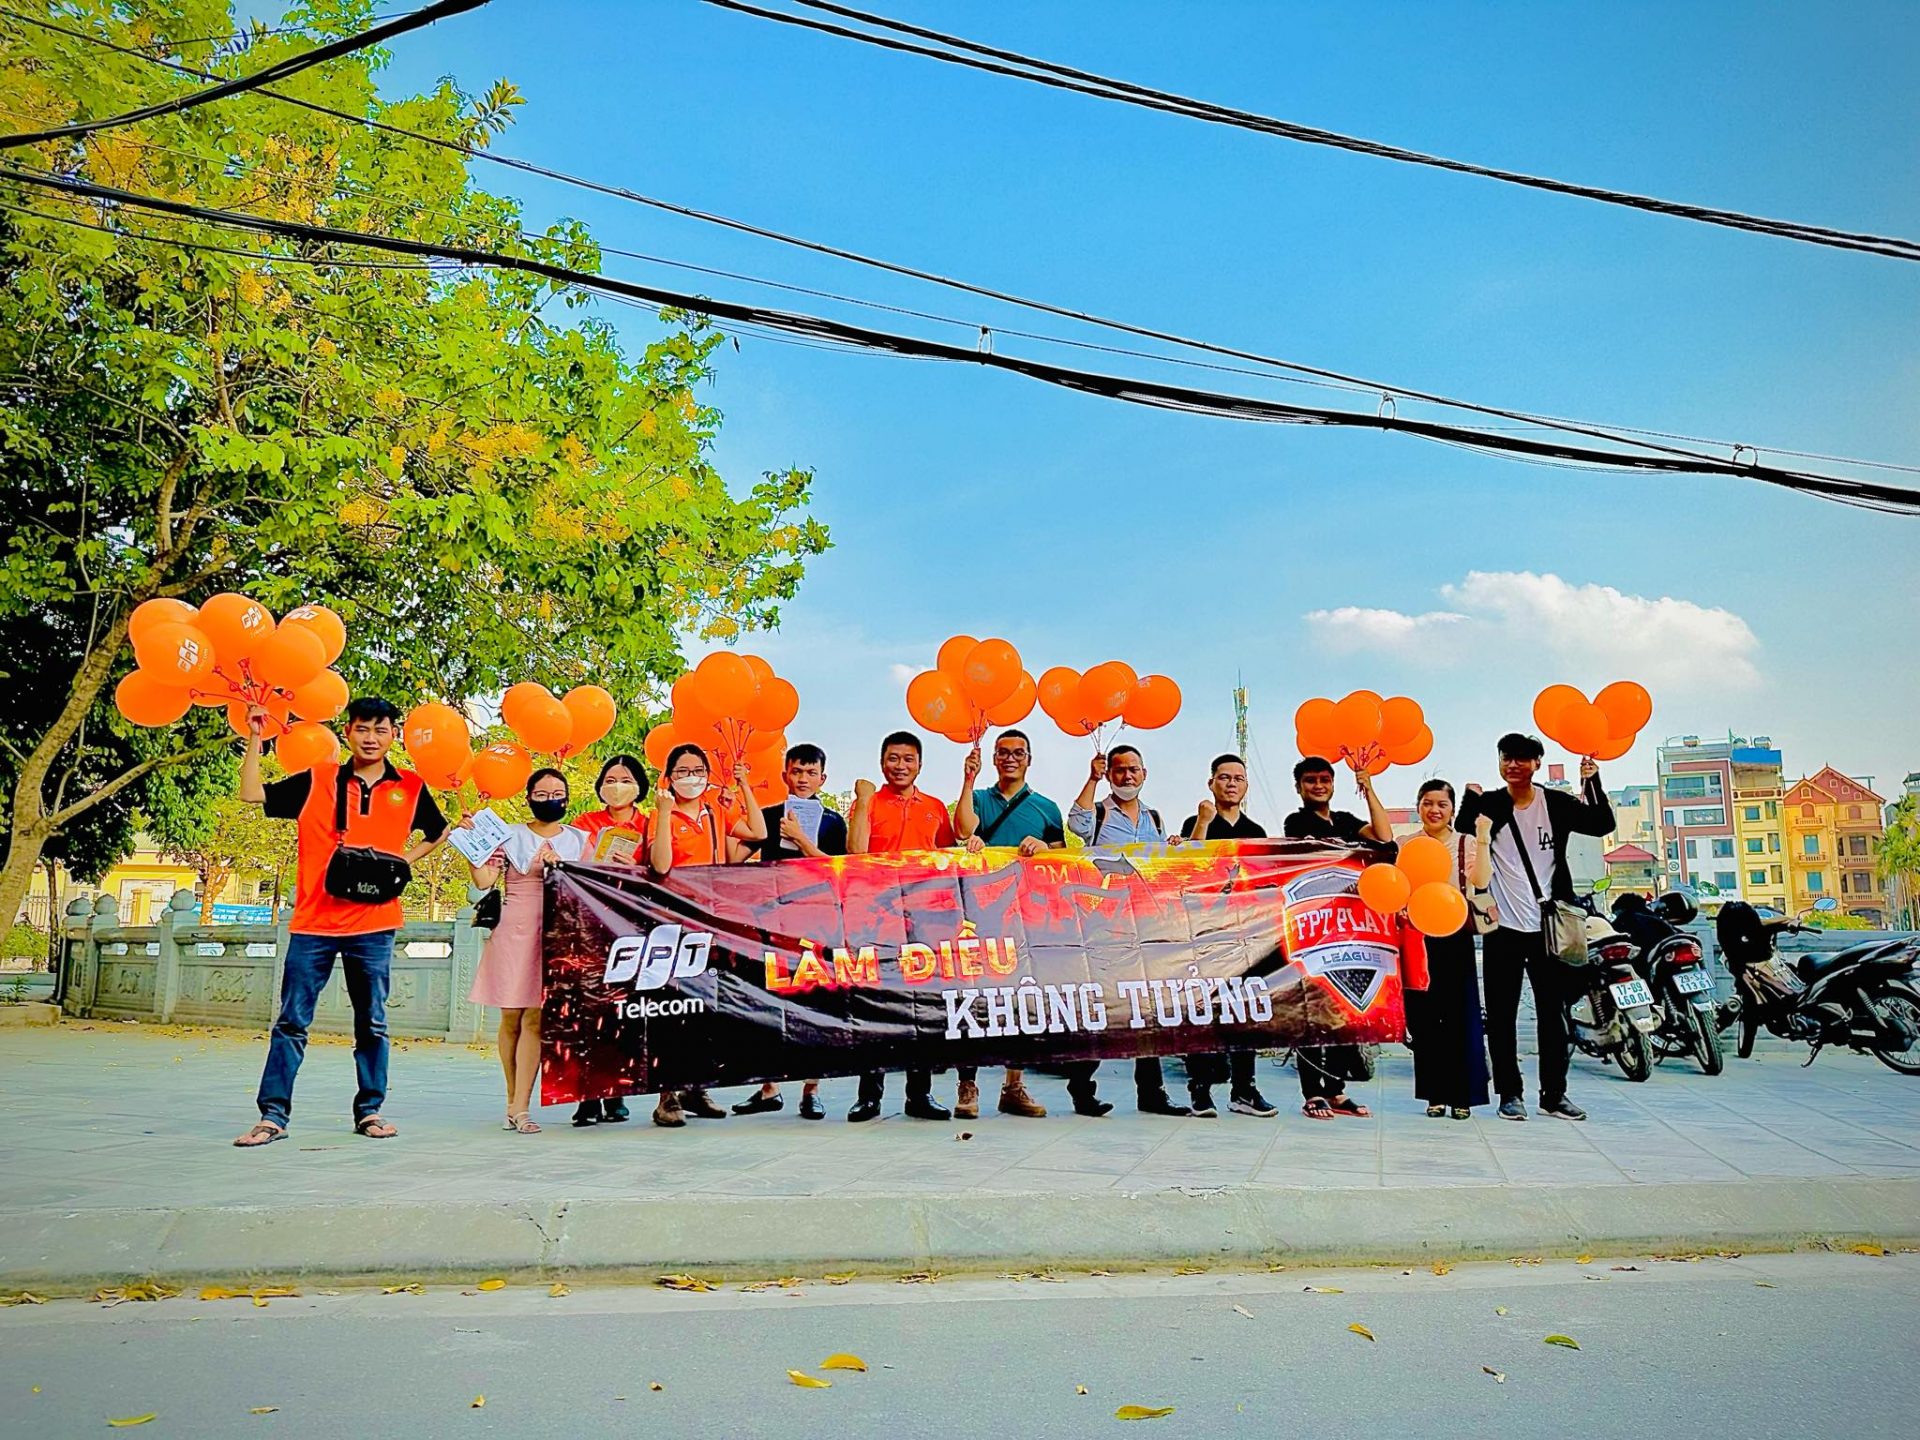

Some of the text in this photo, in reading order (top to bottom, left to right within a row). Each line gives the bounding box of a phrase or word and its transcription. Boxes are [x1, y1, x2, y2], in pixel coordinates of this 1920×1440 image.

[1537, 826, 1554, 850] LA
[1295, 907, 1391, 941] FPT PLAY
[608, 939, 708, 974] FPT
[765, 920, 1018, 990] LÀM ĐIỀU
[1321, 951, 1382, 965] LEAGUE
[614, 996, 704, 1020] Telecom
[942, 965, 1273, 1040] KHÔNG TƯỞNG
